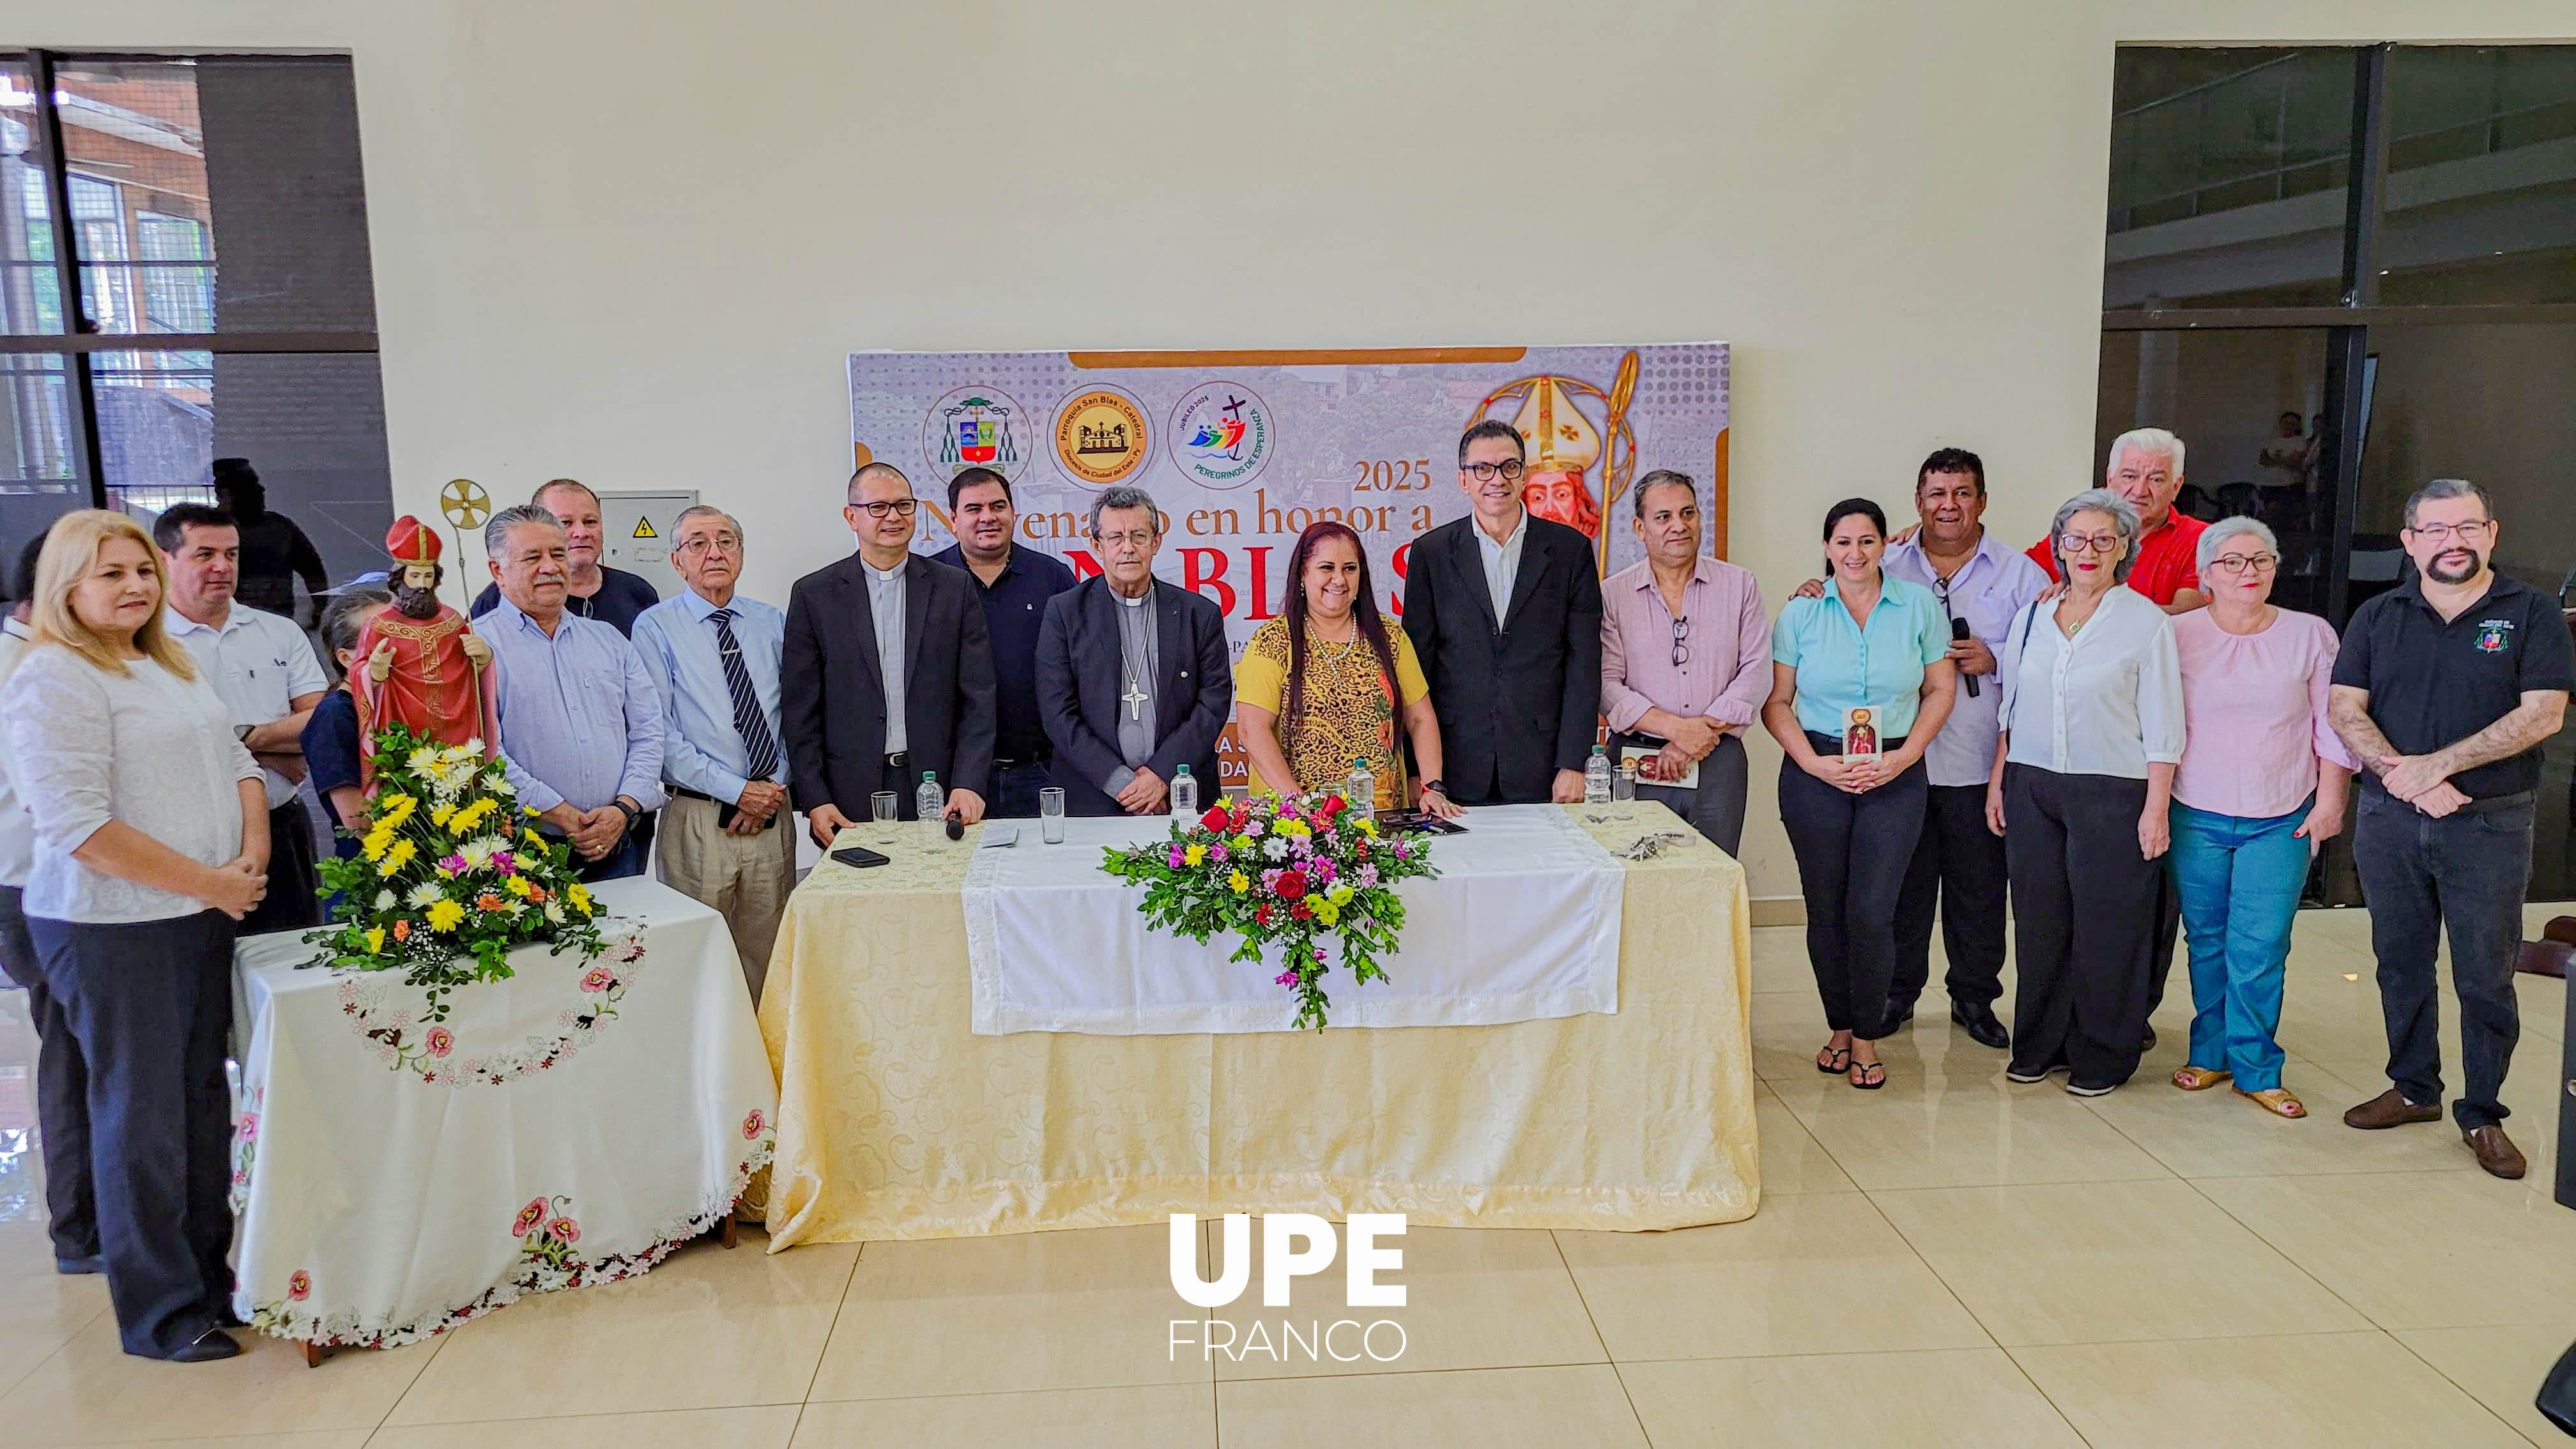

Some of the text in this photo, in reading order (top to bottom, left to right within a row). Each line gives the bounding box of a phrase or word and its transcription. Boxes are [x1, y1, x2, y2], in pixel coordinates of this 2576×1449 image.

[1061, 405, 1082, 441] Parroquia
[1082, 397, 1098, 407] San
[1100, 396, 1118, 406] Blas
[1124, 406, 1142, 439] Catedral
[1179, 395, 1209, 431] JUBILEO 2025
[1194, 408, 1264, 479] PEREGRINOS DE ESPERANZA
[1122, 459, 1134, 471] Este
[1353, 459, 1431, 491] 2025
[1186, 509, 1241, 535] en
[1254, 487, 1396, 534] honor
[1411, 505, 1432, 531] a
